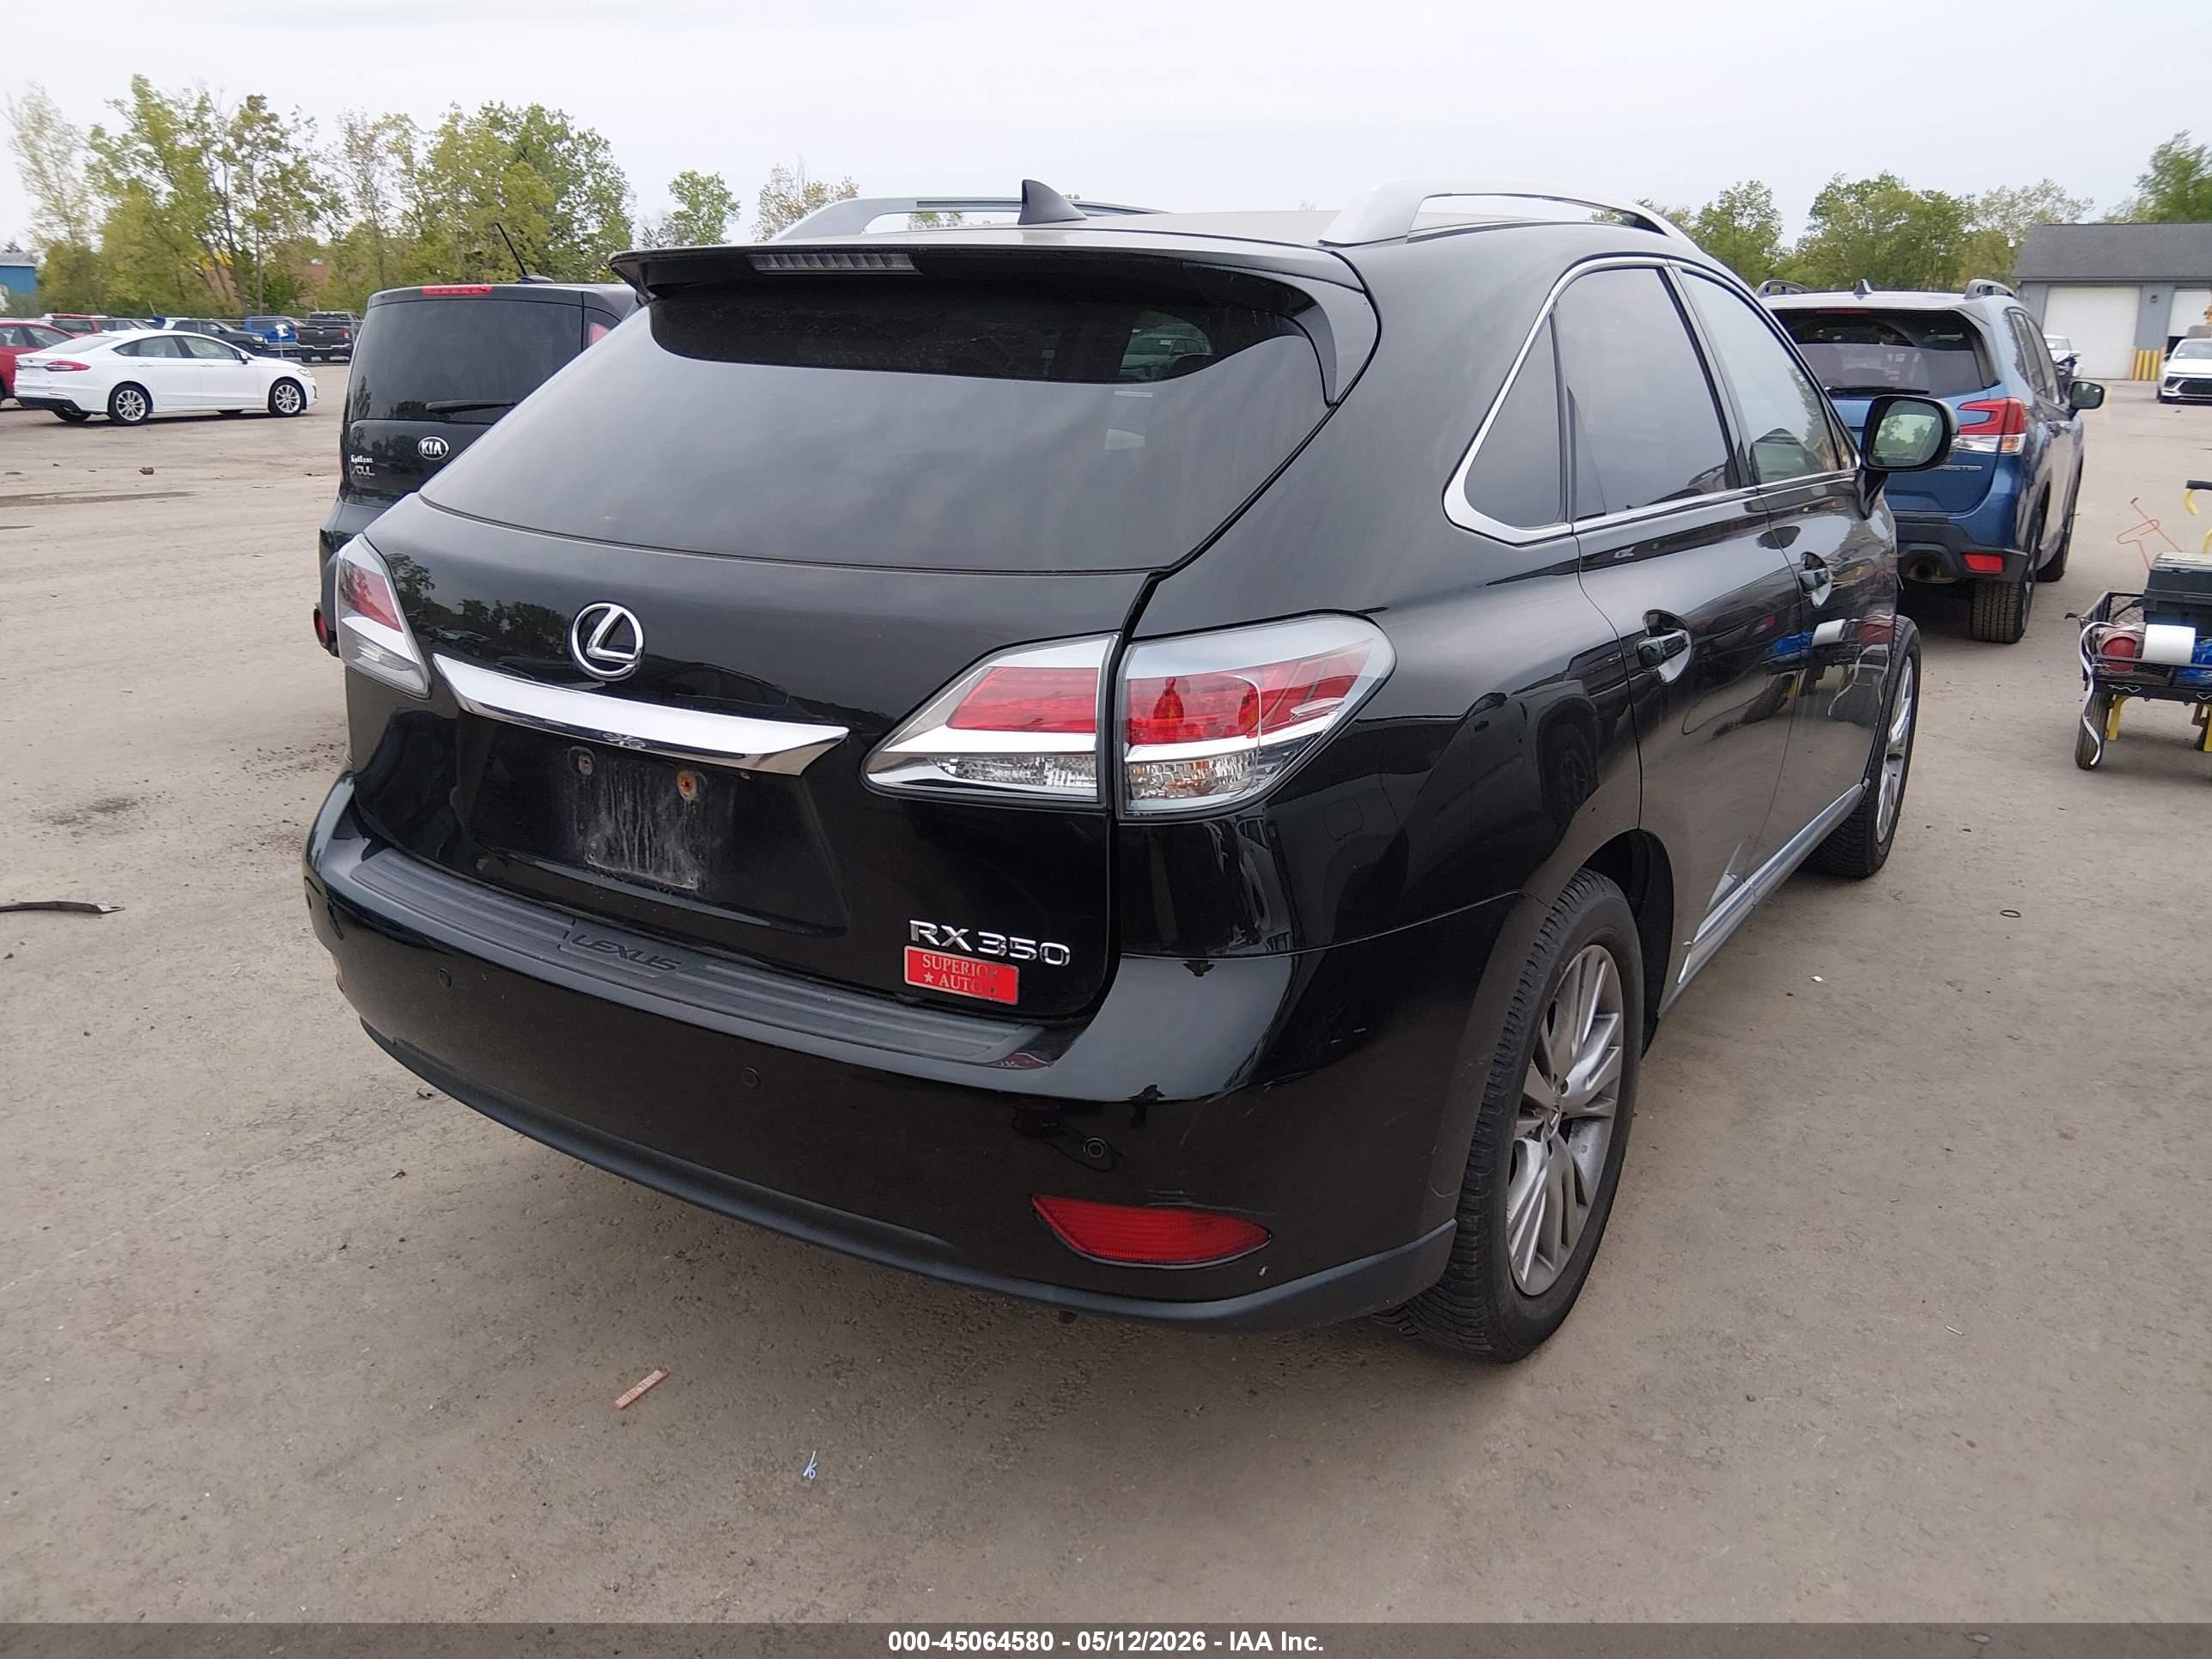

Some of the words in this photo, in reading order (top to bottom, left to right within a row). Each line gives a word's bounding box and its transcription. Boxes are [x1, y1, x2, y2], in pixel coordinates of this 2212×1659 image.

[420, 441, 443, 456] KIA
[570, 933, 682, 971] LEXUS
[908, 919, 973, 952] RX
[977, 931, 1071, 967] 350
